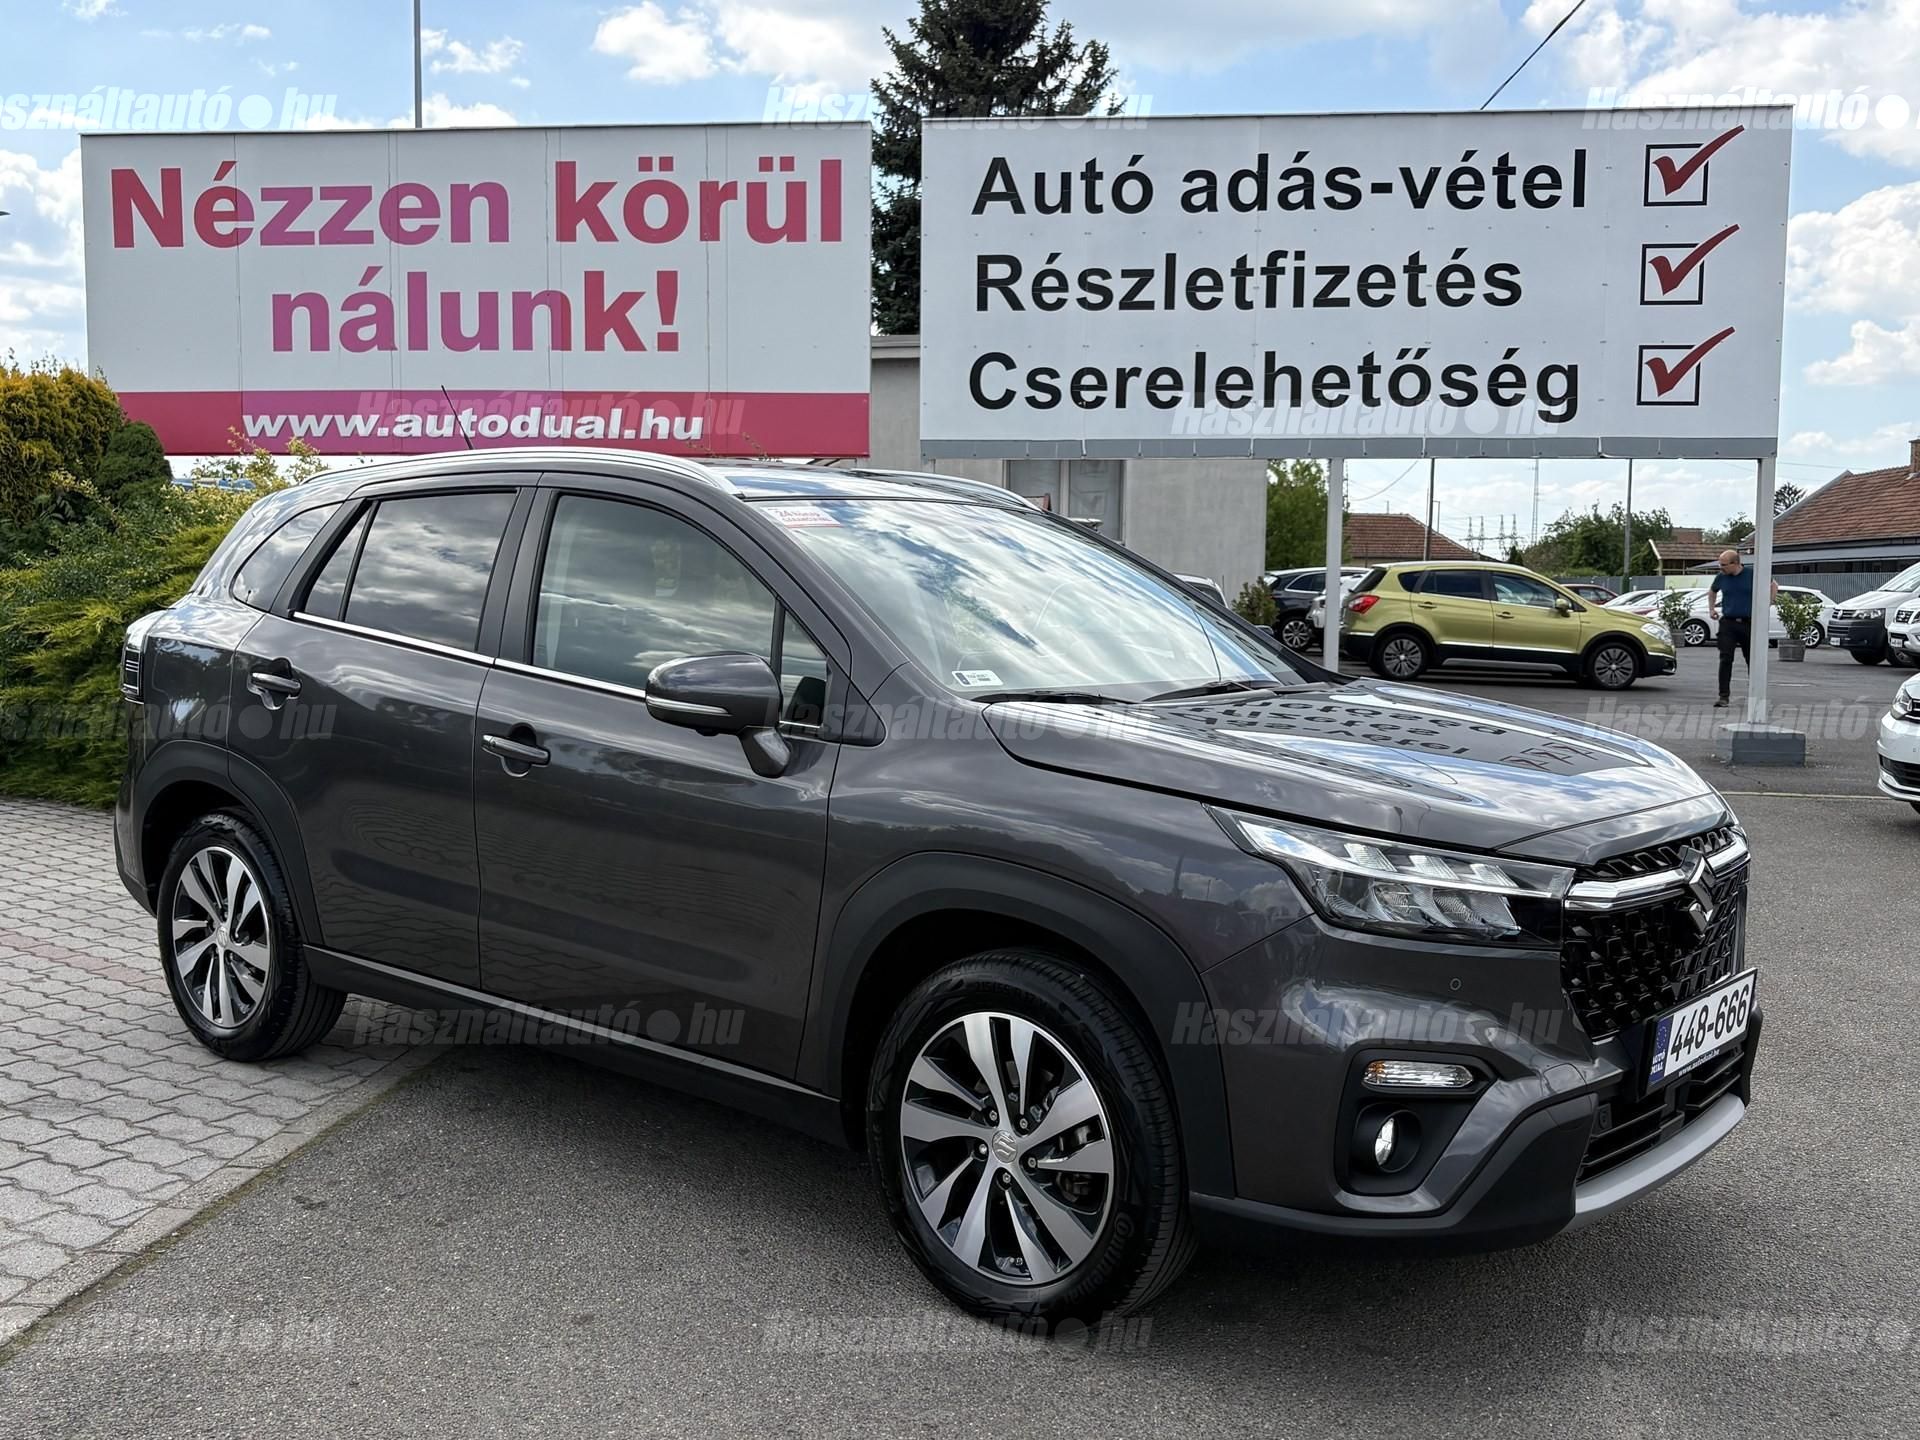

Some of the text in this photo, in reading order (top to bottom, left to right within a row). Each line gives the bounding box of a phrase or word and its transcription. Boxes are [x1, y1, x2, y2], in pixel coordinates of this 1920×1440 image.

[111, 156, 842, 249] Nézzen körül
[971, 149, 1587, 215] Autó adás-vétel
[272, 266, 679, 353] nálunk!
[976, 248, 1523, 312] Részletfizetés
[242, 407, 704, 440] www.autodual.hu
[969, 347, 1579, 424] Cserelehetőség
[1671, 984, 1750, 1062] 448-666
